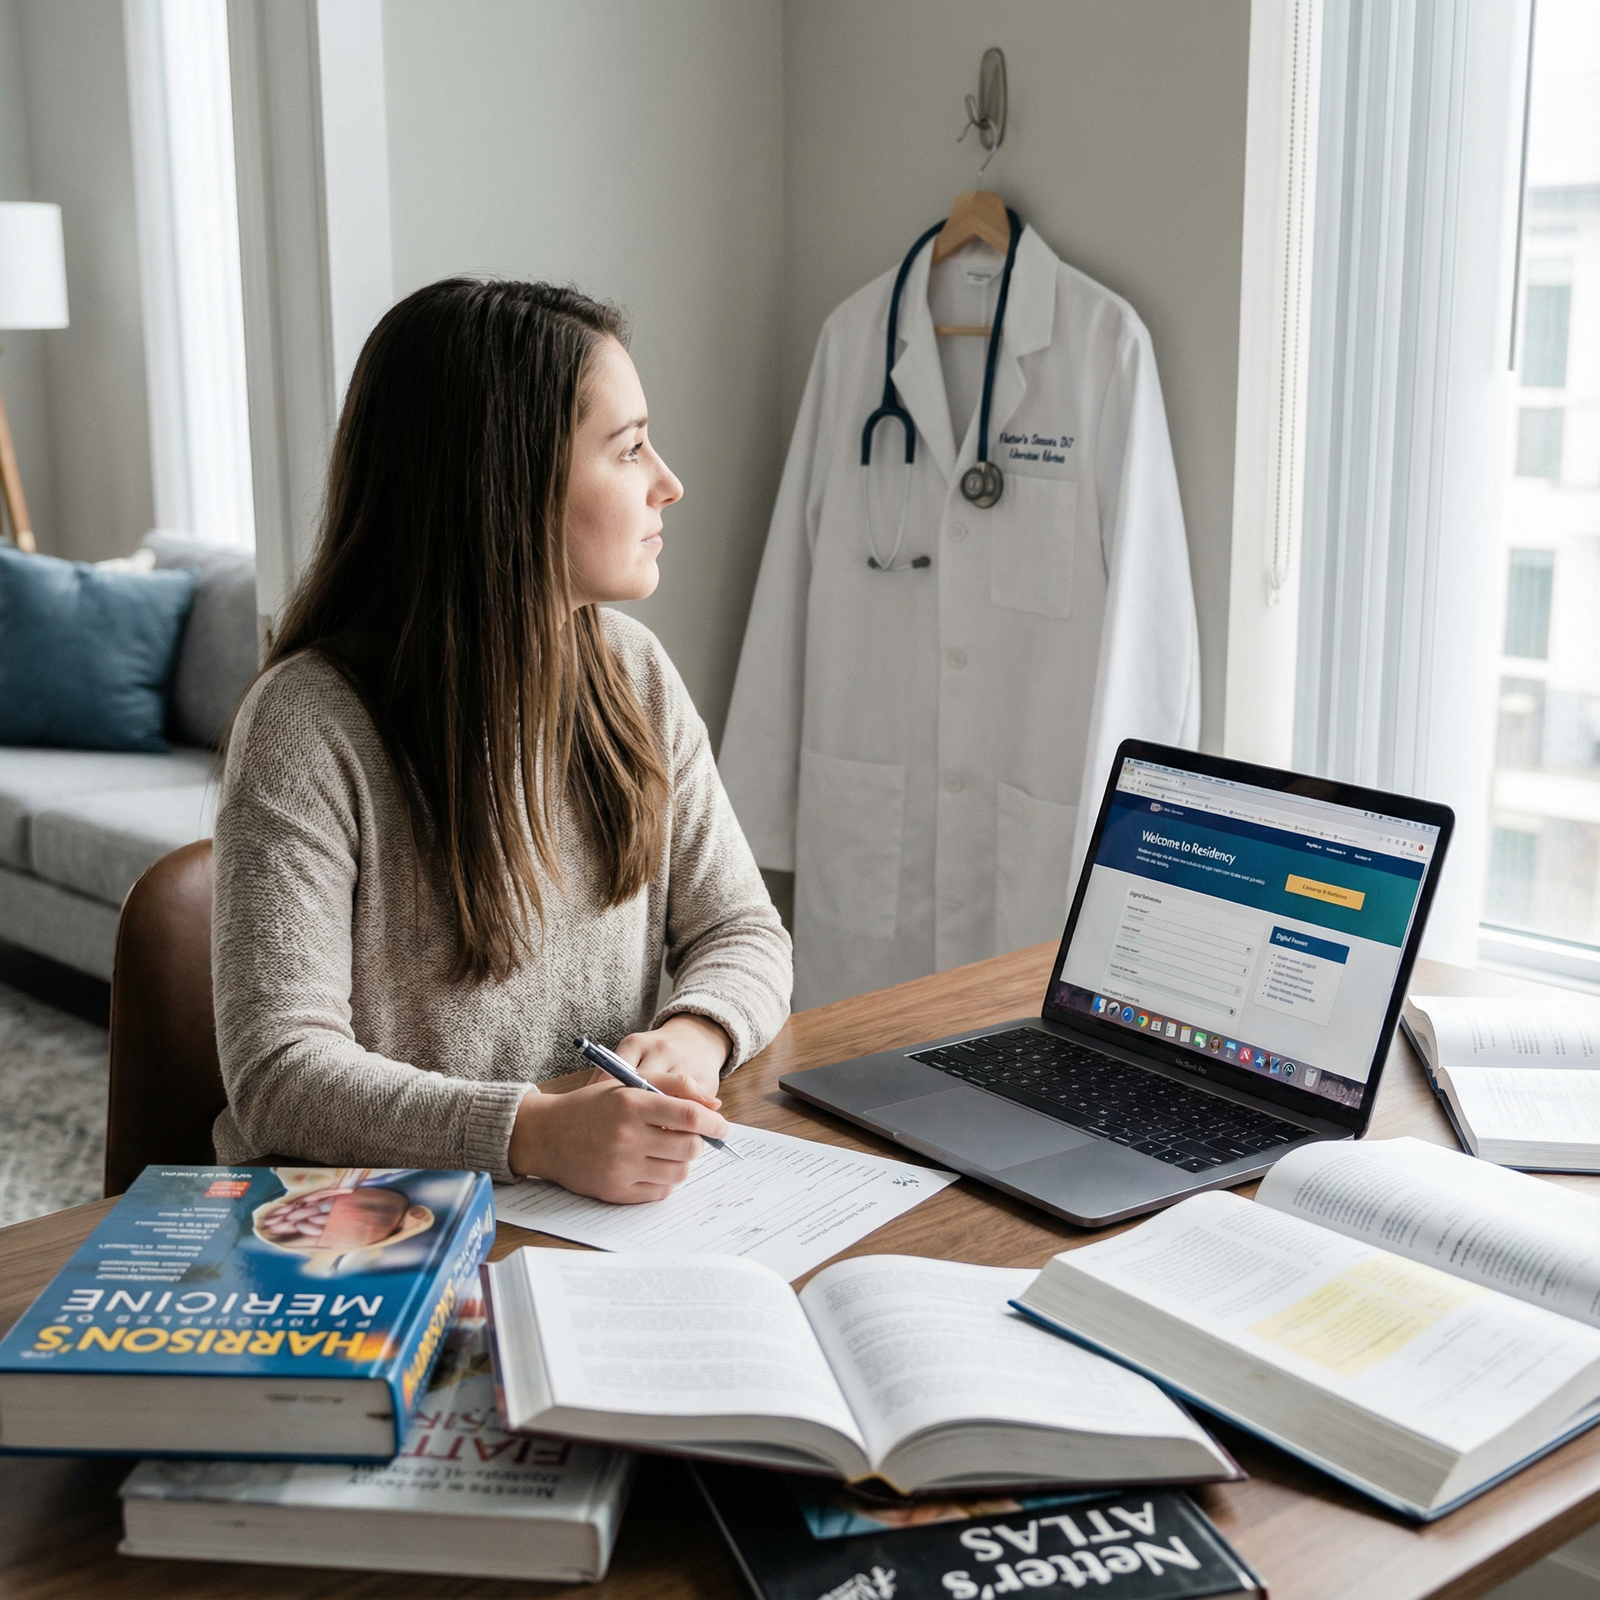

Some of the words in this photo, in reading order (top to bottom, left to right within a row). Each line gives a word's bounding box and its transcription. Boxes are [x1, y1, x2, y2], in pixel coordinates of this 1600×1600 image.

[1142, 829, 1180, 850] Welcome
[1192, 843, 1236, 865] Residency
[61, 1289, 384, 1317] MERICINE
[33, 1325, 368, 1358] HARRISON'S
[960, 1501, 1157, 1562] ATLAS
[941, 1536, 1201, 1600] Netter's
